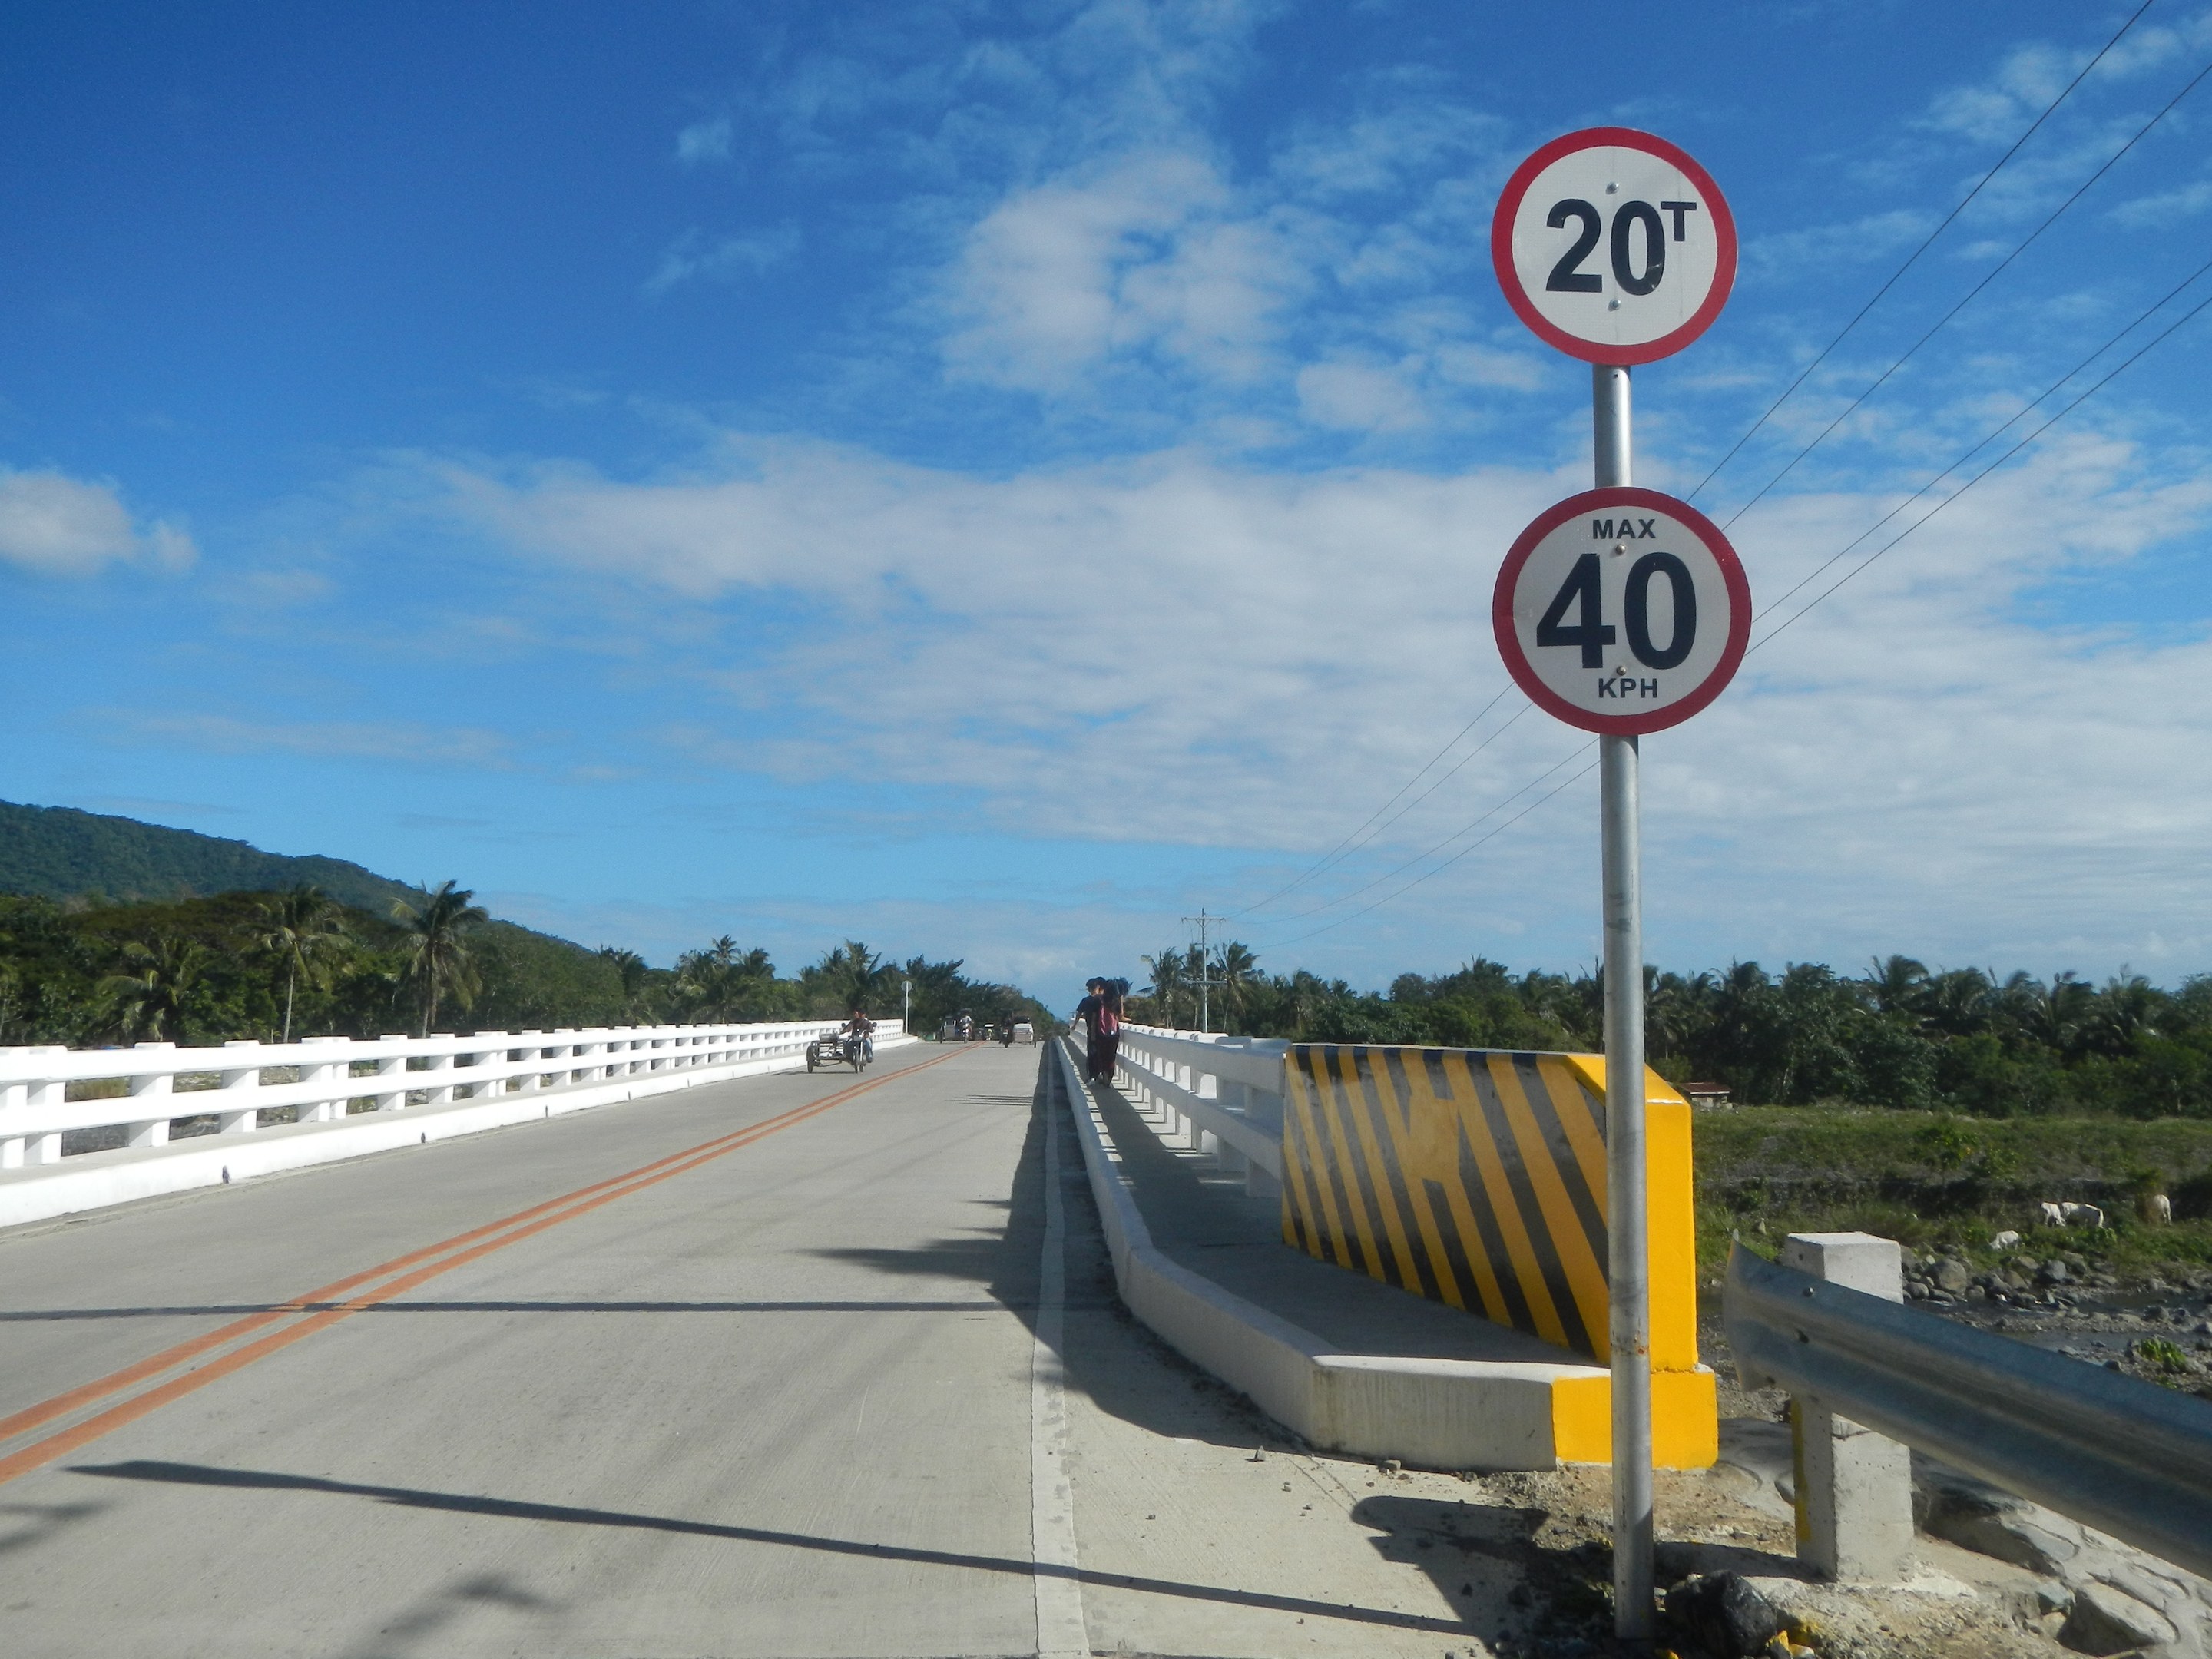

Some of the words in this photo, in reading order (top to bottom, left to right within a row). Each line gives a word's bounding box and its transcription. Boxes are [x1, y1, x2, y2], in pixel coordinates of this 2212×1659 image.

[1593, 519, 1656, 539] MAX
[1536, 552, 1697, 670] 40
[1598, 678, 1657, 698] KPH
